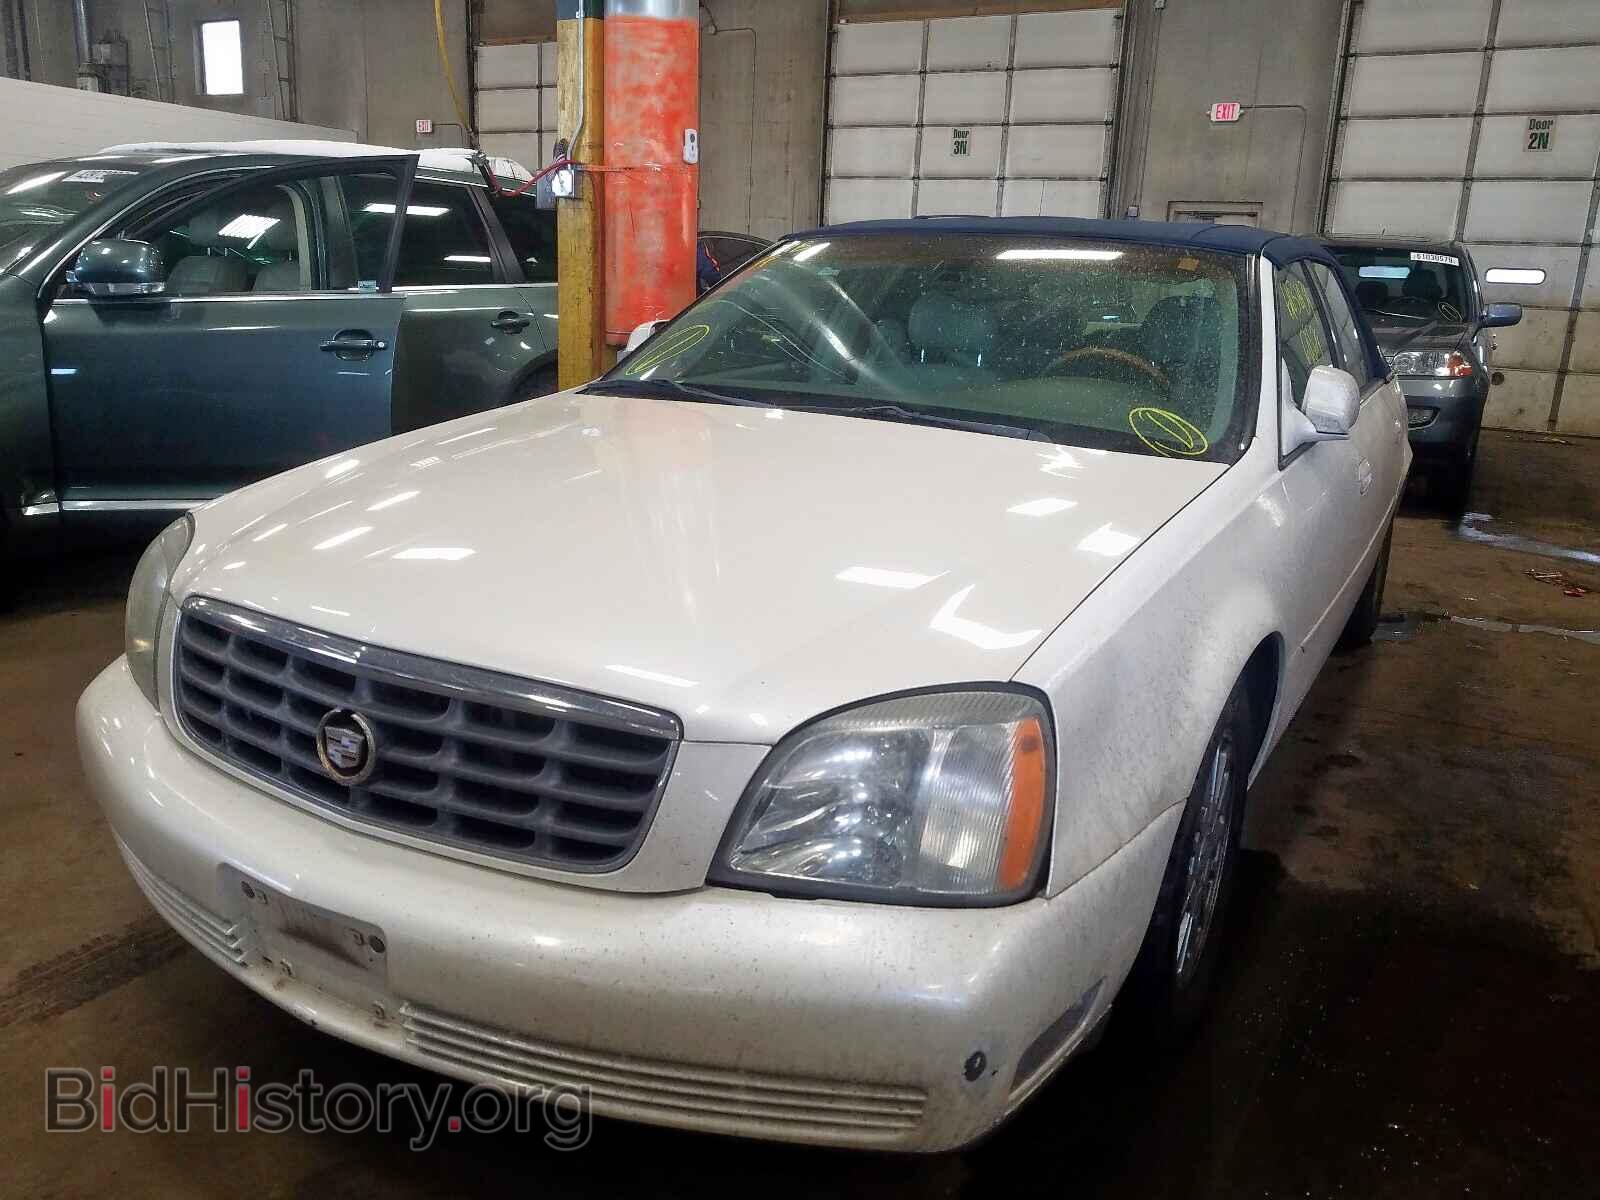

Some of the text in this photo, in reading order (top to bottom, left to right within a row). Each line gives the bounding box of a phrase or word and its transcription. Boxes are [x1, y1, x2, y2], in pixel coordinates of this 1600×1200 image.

[1216, 103, 1236, 120] EXIT
[1529, 118, 1553, 130] Door
[953, 128, 970, 138] Door
[1528, 132, 1549, 149] 2N
[953, 140, 968, 155] 3N
